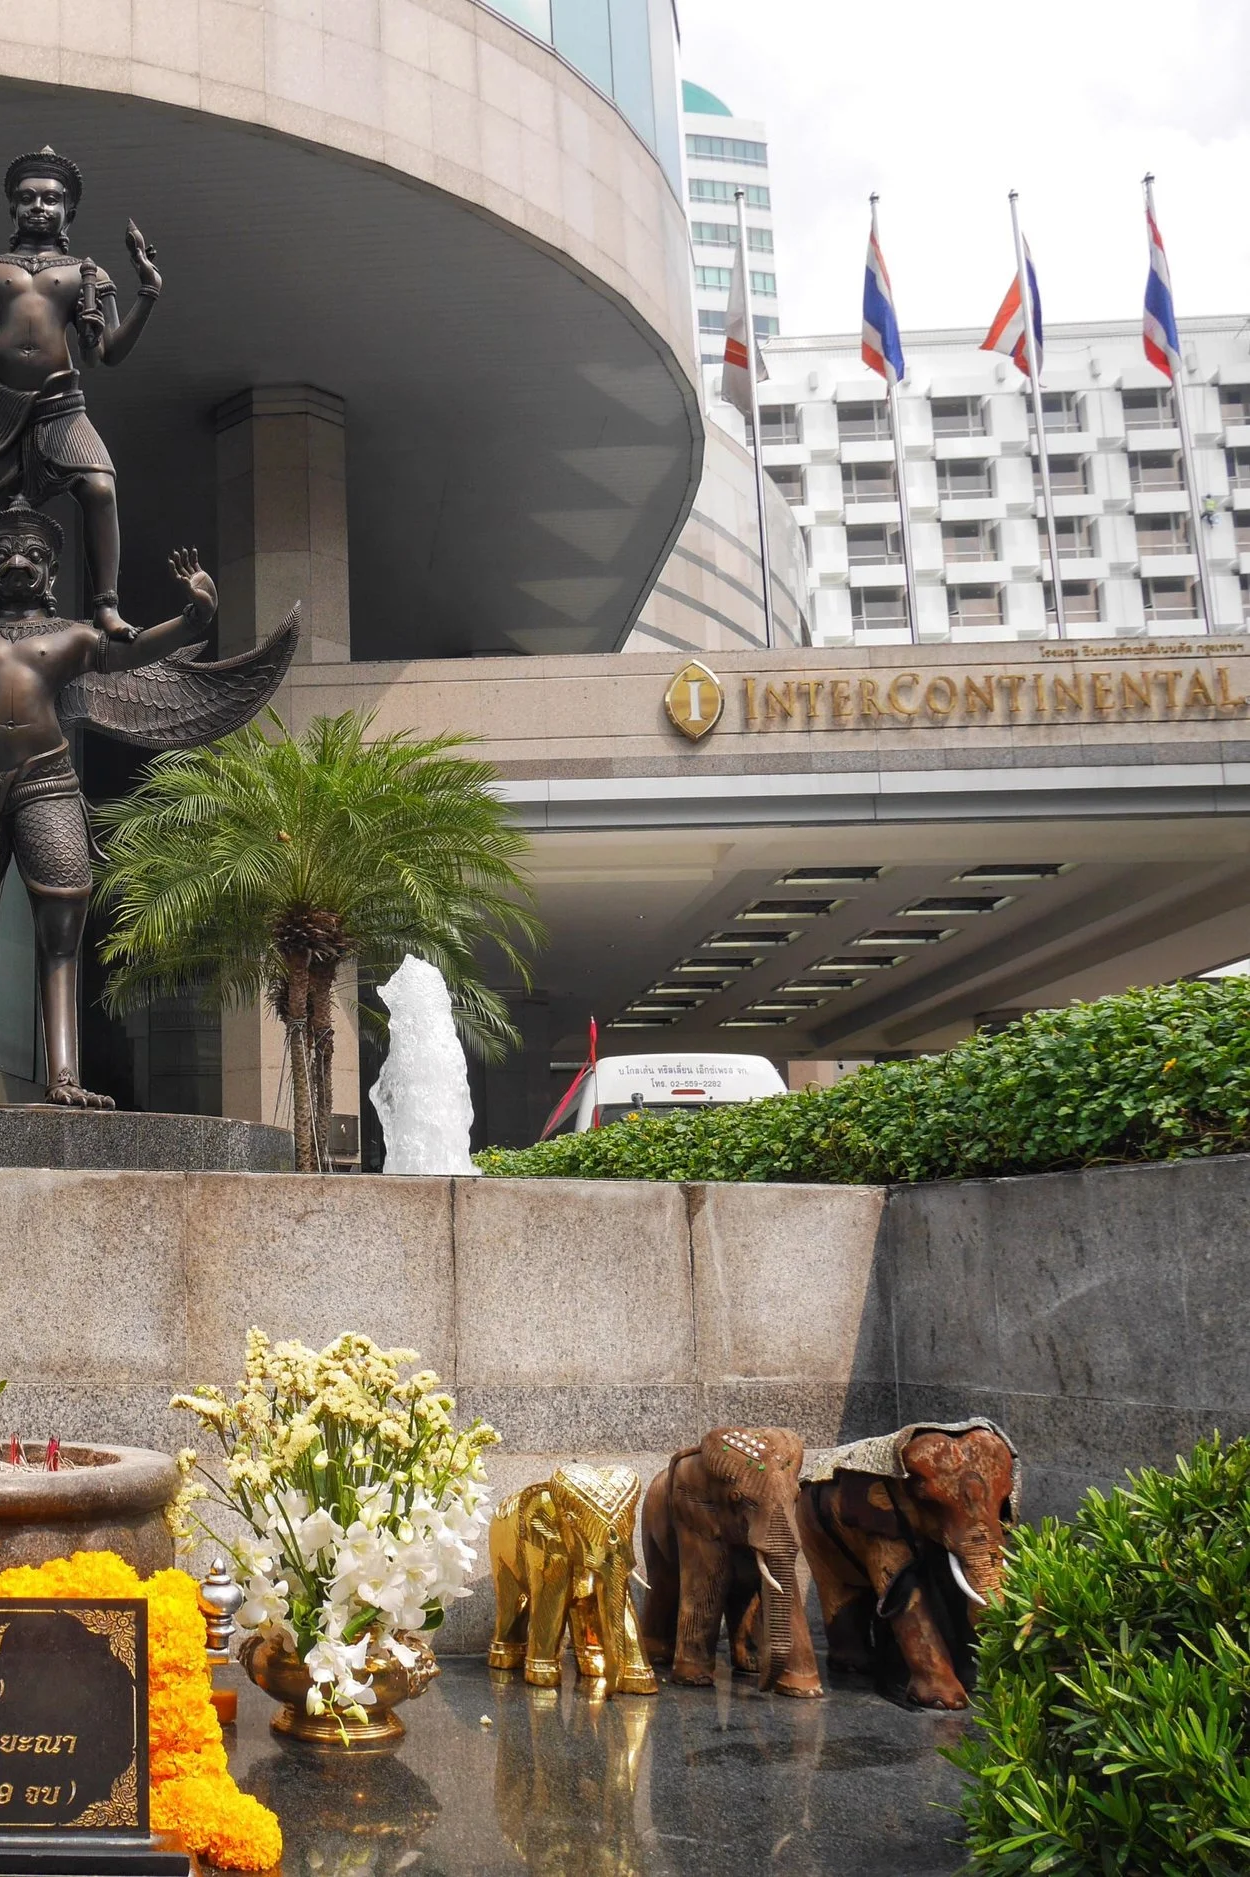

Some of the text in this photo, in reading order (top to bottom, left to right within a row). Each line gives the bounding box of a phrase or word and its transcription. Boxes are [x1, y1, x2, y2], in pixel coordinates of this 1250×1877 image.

[1039, 645, 1079, 658] โรงแรม
[651, 1078, 667, 1088] โทร.
